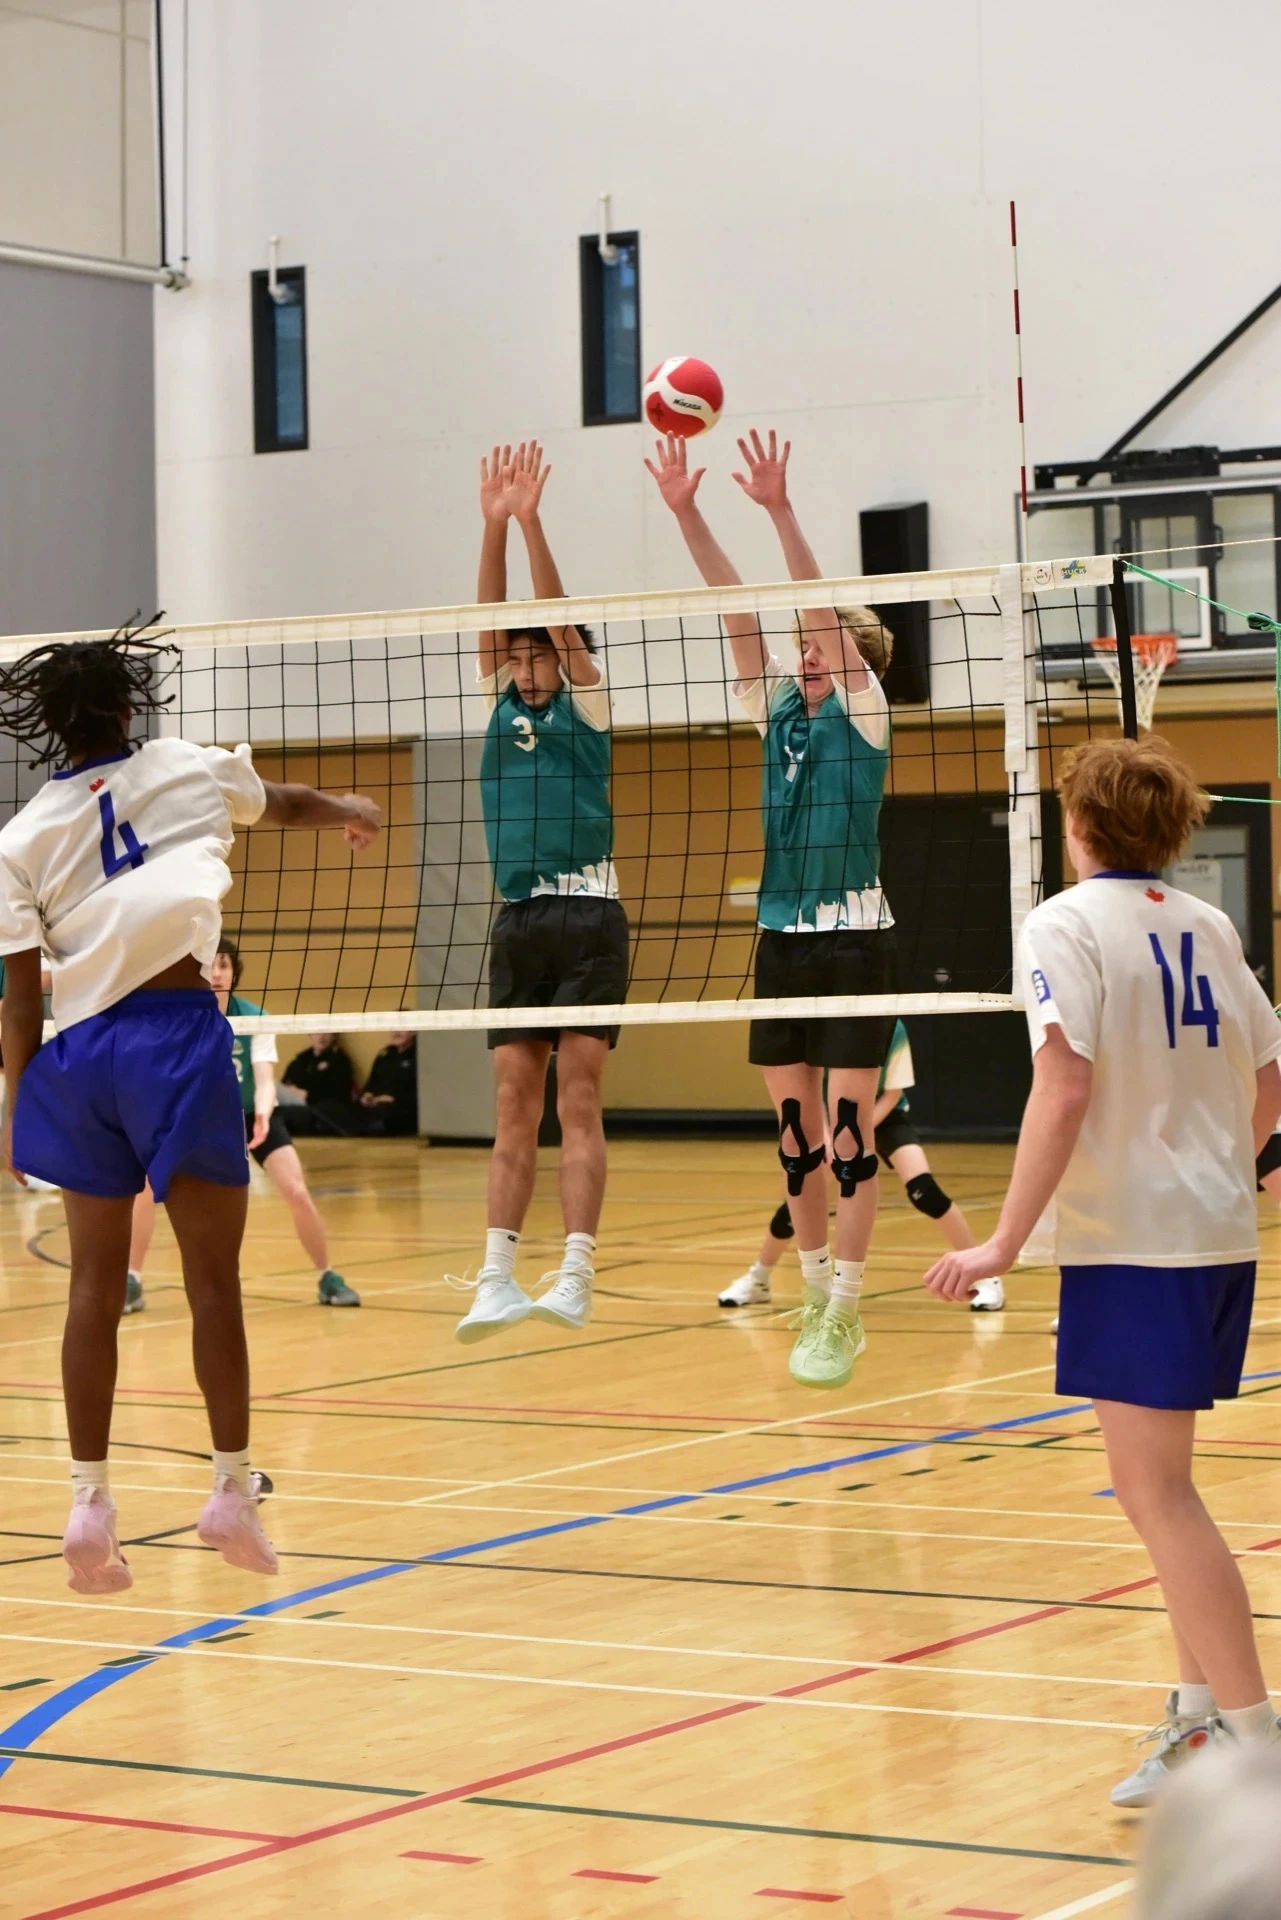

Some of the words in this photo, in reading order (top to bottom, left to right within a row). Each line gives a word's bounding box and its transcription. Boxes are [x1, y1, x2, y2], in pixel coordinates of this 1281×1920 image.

[1062, 567, 1086, 577] HUCK
[511, 716, 538, 752] 3
[98, 790, 149, 878] 4
[1148, 931, 1220, 1049] 14
